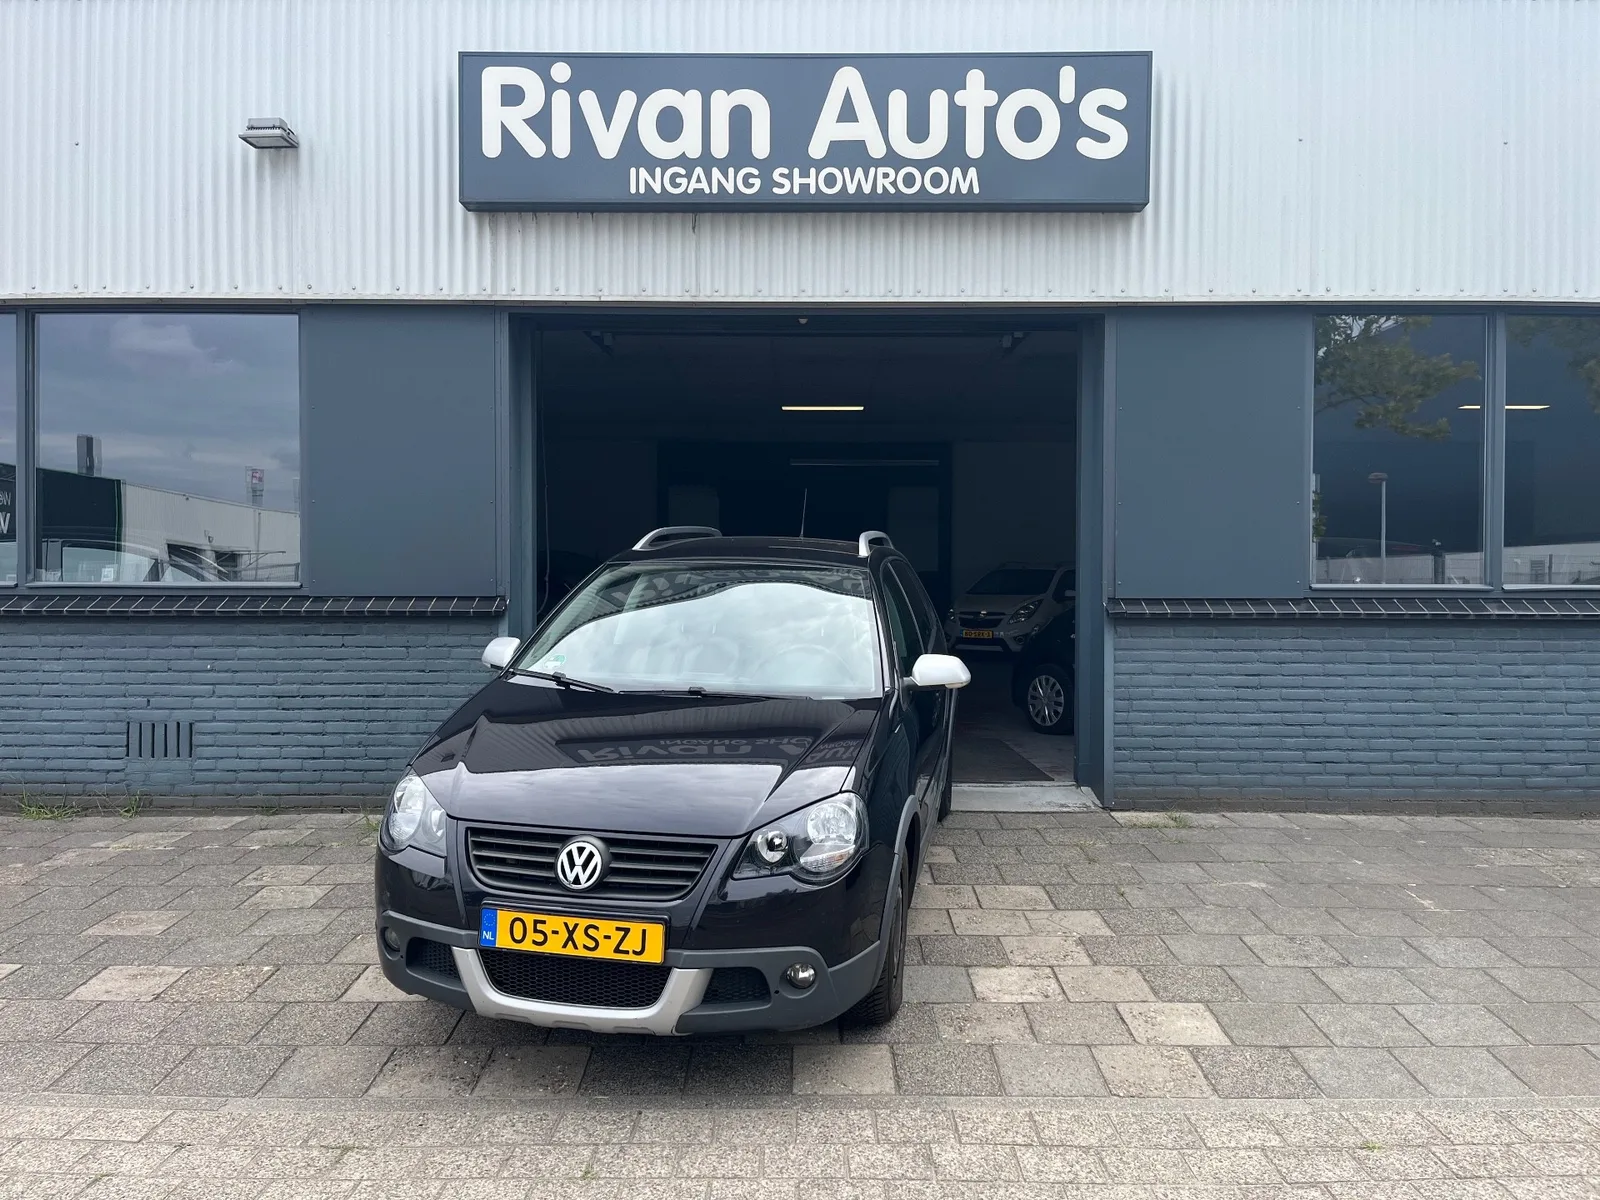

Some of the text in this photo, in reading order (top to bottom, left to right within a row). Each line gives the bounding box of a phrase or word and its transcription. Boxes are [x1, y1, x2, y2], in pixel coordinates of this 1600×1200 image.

[480, 62, 1130, 161] Rivan Auto's
[629, 166, 981, 196] INGANG SHOWROOM
[557, 840, 602, 888] VW
[482, 917, 647, 956] NL 05-XS-ZJ
